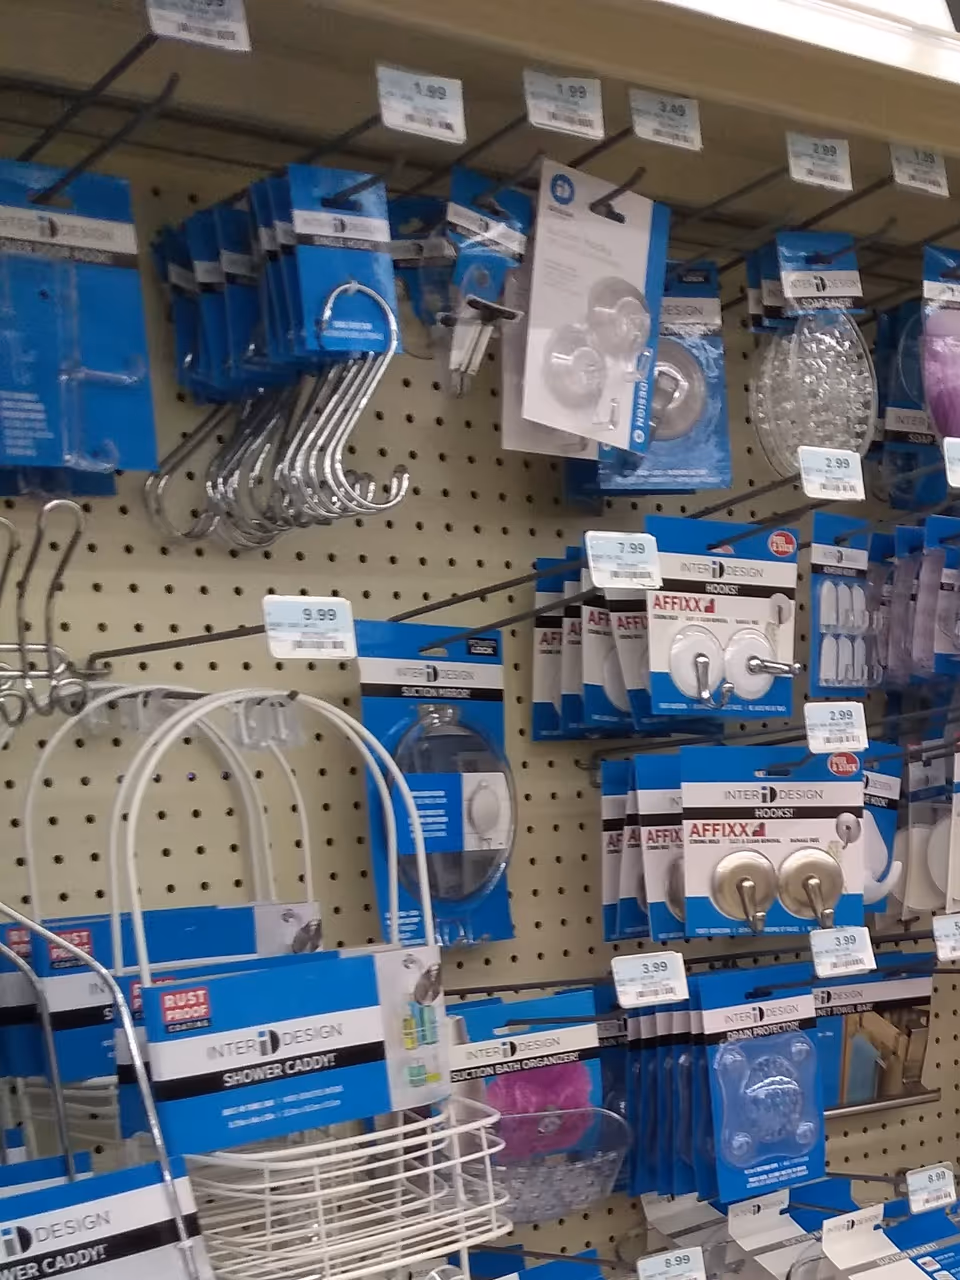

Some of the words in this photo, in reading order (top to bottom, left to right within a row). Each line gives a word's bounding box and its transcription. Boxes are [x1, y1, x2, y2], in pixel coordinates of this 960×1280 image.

[825, 457, 850, 470] 2.99
[617, 541, 646, 555] 7.99
[681, 561, 711, 573] INTER
[725, 565, 764, 577] DESIGN
[652, 595, 704, 612] AFFIXX
[302, 607, 337, 621] 9.99
[829, 710, 853, 722] 2.99
[724, 789, 760, 801] INTER
[779, 789, 824, 801] DESIGN
[755, 807, 794, 819] HOOKS!
[688, 822, 750, 838] AFFIXX
[835, 935, 858, 947] 3.99
[641, 961, 668, 975] 3.99
[163, 991, 206, 1008] RUST
[725, 1011, 752, 1025] INTER
[765, 1004, 800, 1018] DESIGN
[206, 1038, 258, 1061] INTER
[283, 1022, 344, 1046] DESIGN
[727, 1028, 752, 1041] DRAIN
[466, 1046, 500, 1061] INTER
[519, 1036, 561, 1053] DESIGN
[222, 1061, 283, 1087] SHOWER
[285, 1051, 338, 1074] CADDY!
[451, 1066, 493, 1082] SUCTION
[495, 1062, 521, 1075] BATH
[522, 1052, 580, 1070] ORGANIZER!
[35, 1210, 111, 1244] DESIGN
[41, 1243, 108, 1276] CADDY!
[665, 1254, 691, 1268] 8.99
